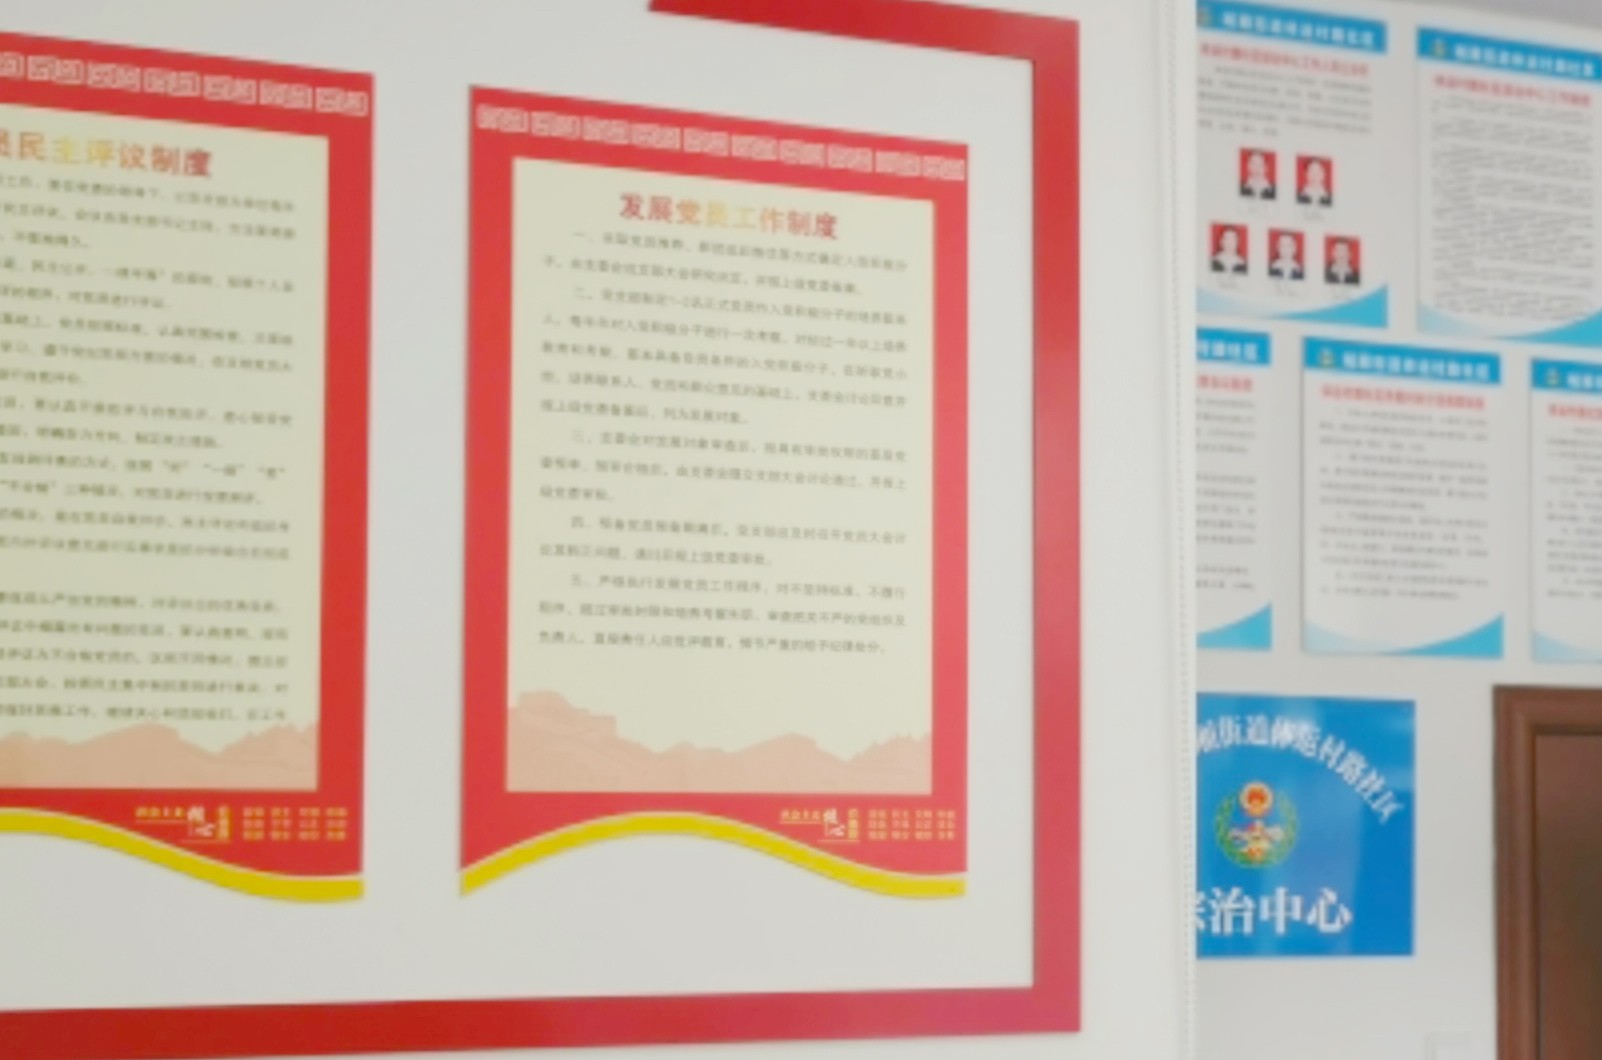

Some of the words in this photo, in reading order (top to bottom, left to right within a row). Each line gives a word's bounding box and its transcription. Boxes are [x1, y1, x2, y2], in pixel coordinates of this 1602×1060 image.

[619, 192, 838, 240] 发展党员工作制度
